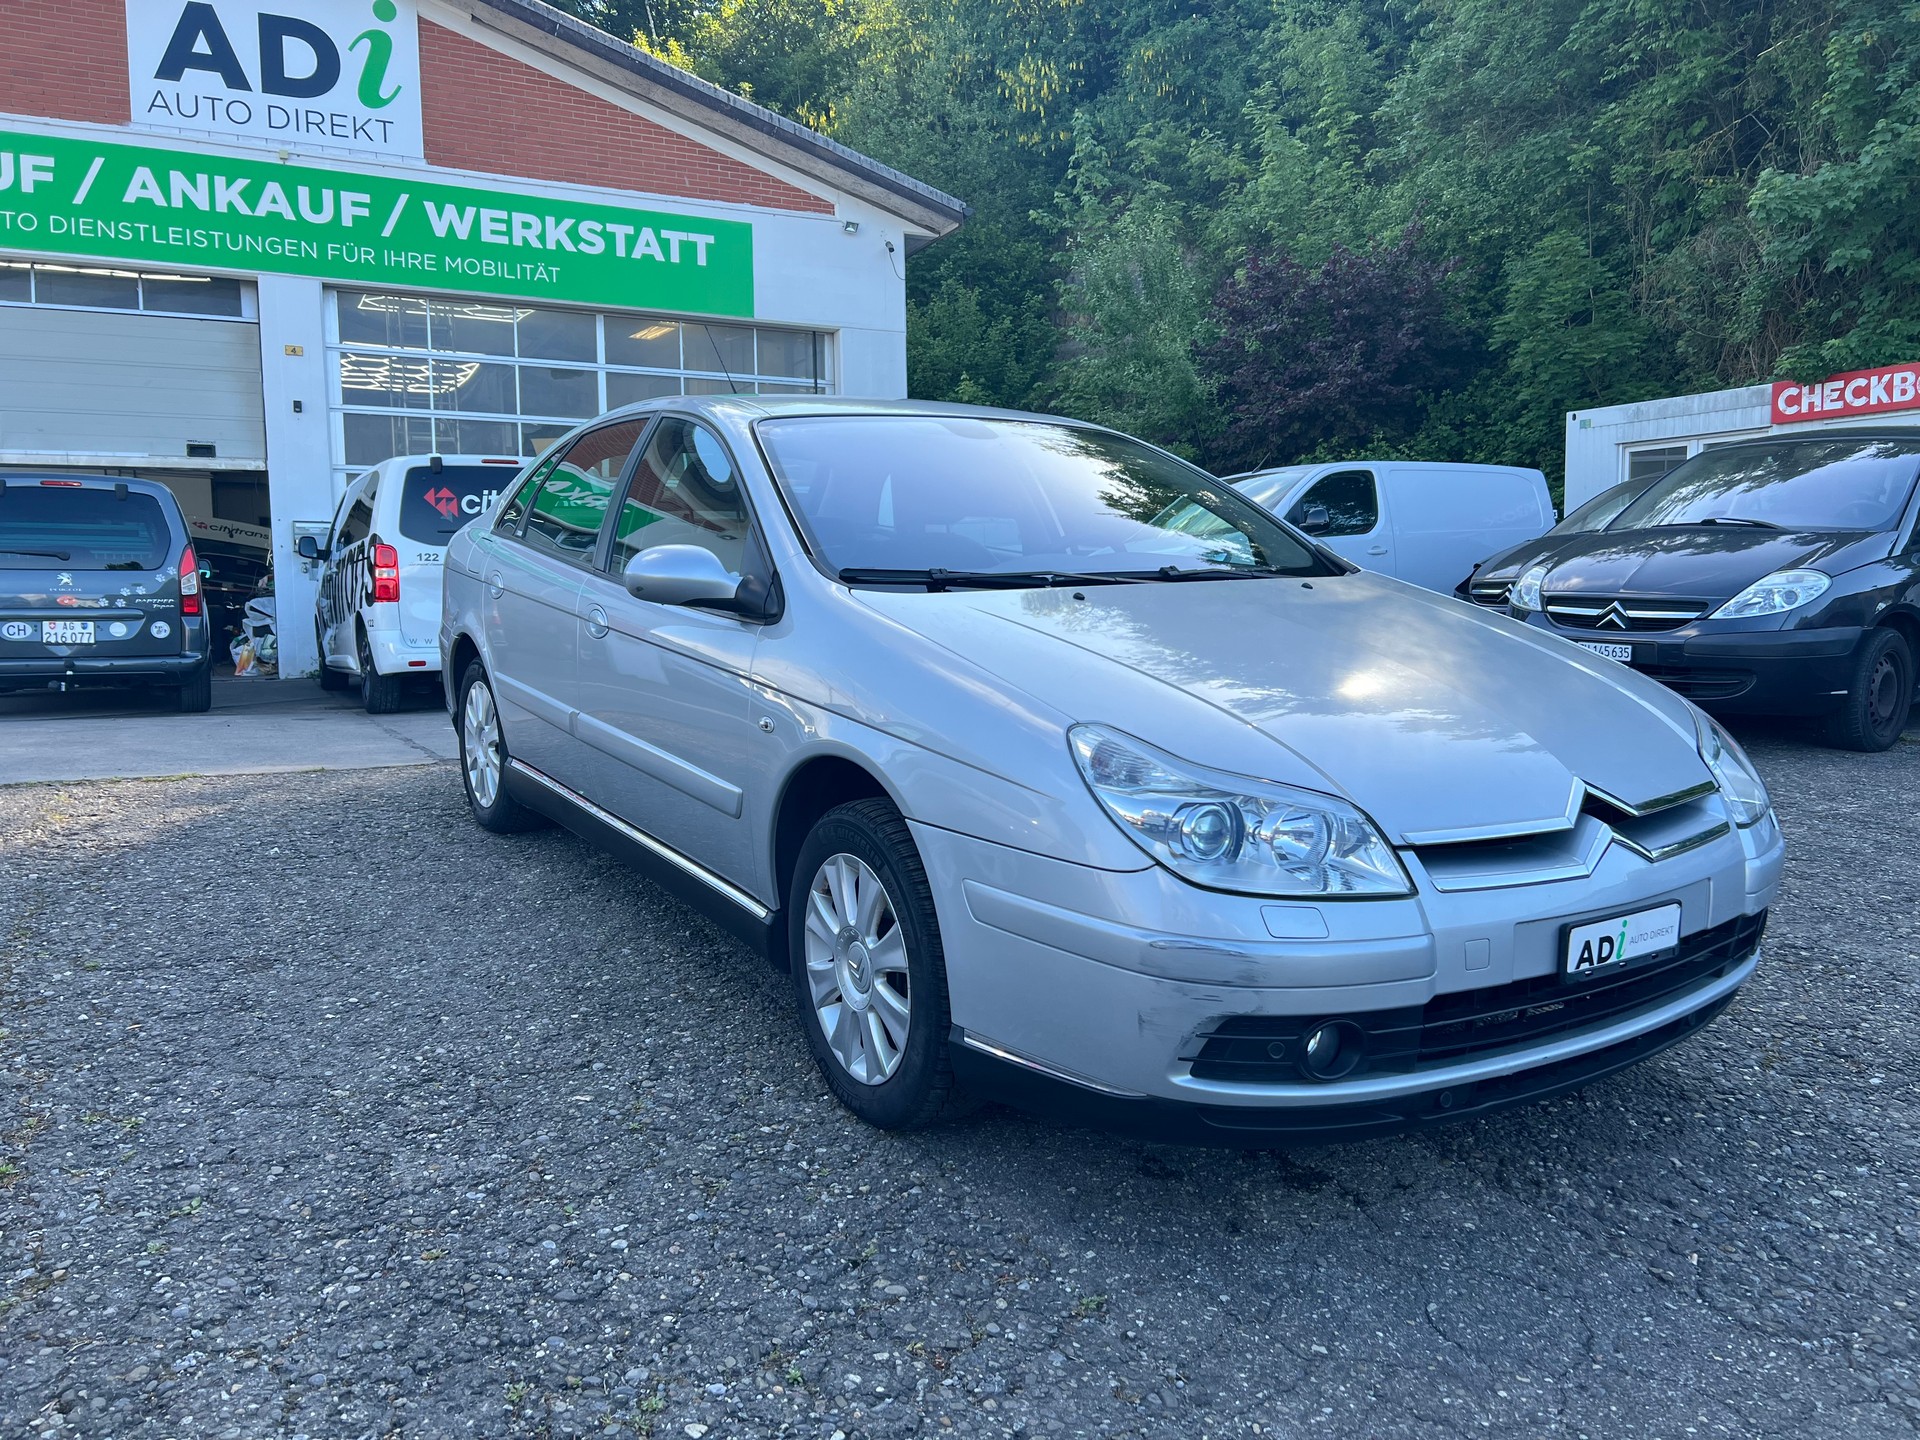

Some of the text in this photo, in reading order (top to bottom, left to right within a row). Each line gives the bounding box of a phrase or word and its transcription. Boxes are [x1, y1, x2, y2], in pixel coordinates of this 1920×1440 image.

[147, 90, 394, 144] AUTO DIREKT
[122, 166, 371, 227] ANKAUF
[423, 200, 715, 266] WERKSTATT
[49, 215, 317, 259] DIENSTLEISTUNGEN
[327, 241, 375, 265] FÜR
[384, 249, 437, 271] IHRE
[445, 256, 561, 283] MOBILITÄT
[1777, 370, 1920, 416] CHECKB
[209, 524, 269, 540] citytrans
[416, 552, 440, 562] 122
[6, 624, 27, 637] CH
[62, 622, 75, 631] AG
[1629, 925, 1674, 945] AUTO DIREKT
